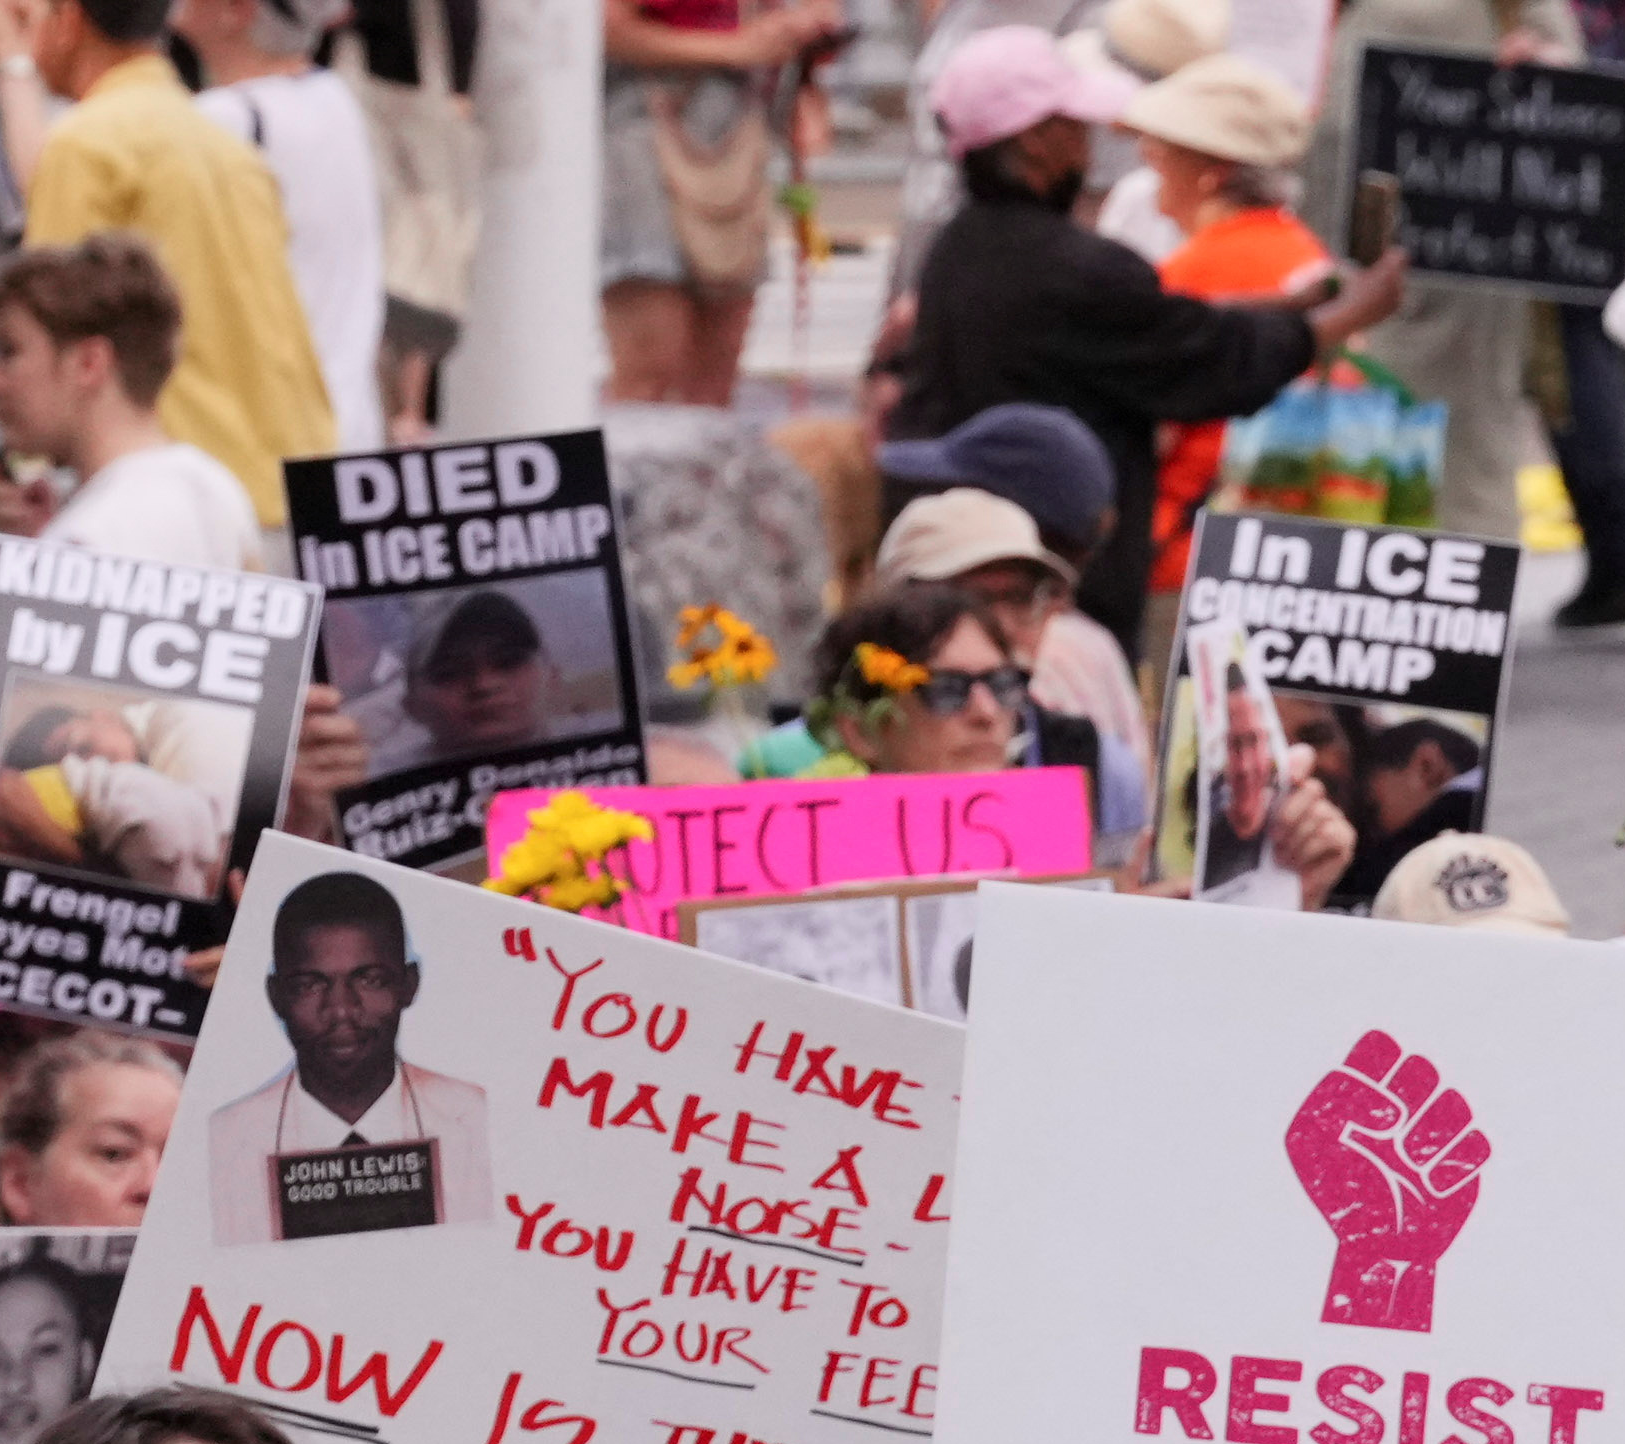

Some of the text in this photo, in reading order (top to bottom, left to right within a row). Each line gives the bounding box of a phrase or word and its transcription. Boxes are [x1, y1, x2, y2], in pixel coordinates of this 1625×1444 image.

[332, 439, 562, 526] DIED
[362, 522, 455, 587] ICE
[456, 502, 611, 577] CAMP
[1228, 517, 1486, 604] In ICE
[6, 609, 271, 701] by ICE
[1188, 576, 1508, 657] CONCENTRATION
[1249, 627, 1437, 695] CAMP
[625, 797, 842, 898] OTECT
[896, 791, 1014, 878] US
[2, 868, 181, 936] Frengel
[733, 1019, 923, 1130] HAVE
[283, 1157, 346, 1185] JOHN
[536, 1055, 789, 1176] MAKE
[810, 1144, 872, 1210] A
[287, 1172, 423, 1203] GOOD TROUBLE
[668, 1166, 870, 1258] NOISE
[504, 1194, 636, 1273] YOU
[659, 1237, 819, 1314] HAVE
[169, 1284, 444, 1419] NOW
[595, 1288, 939, 1420] YOUR FEE
